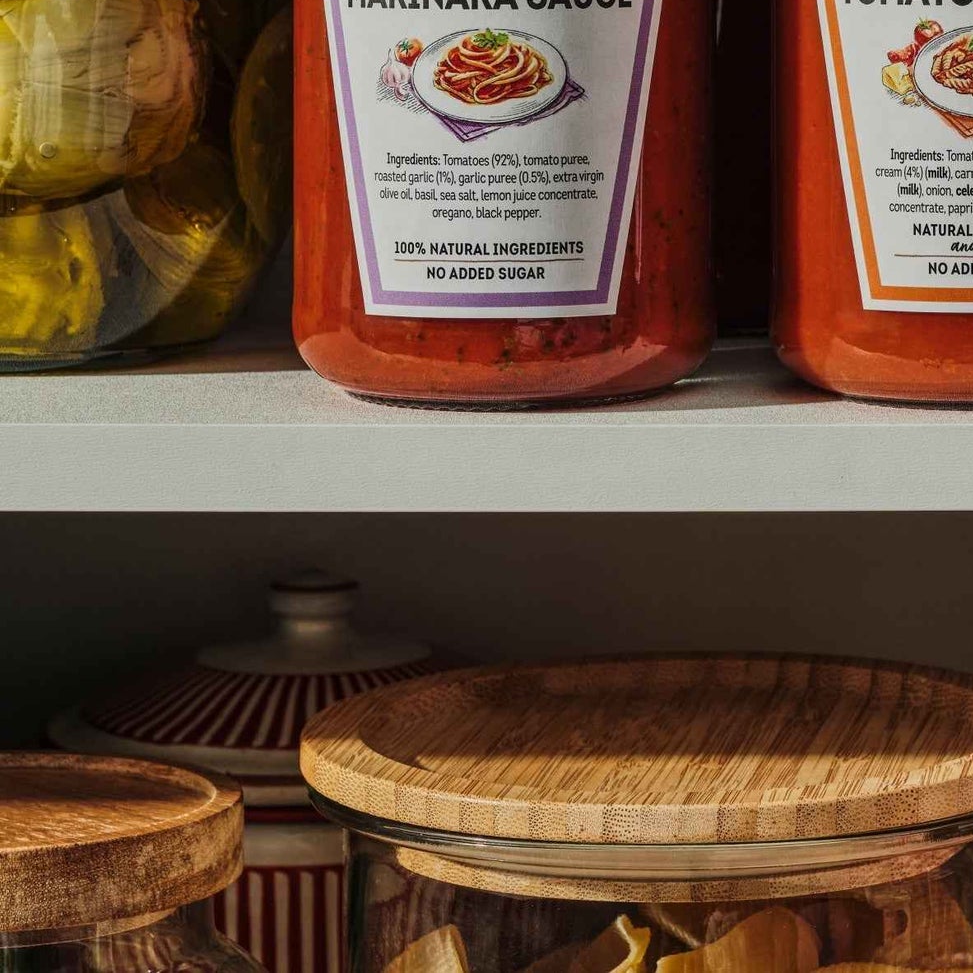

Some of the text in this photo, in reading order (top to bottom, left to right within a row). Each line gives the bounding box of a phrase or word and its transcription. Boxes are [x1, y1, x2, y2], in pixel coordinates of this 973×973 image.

[387, 152, 590, 168] Ingredients: Tomatoes (92%), tomato puree,
[890, 148, 944, 164] Ingredients:
[374, 170, 604, 187] roasted garlic (1%), garlic puree (0.5%), extra virgin
[875, 167, 903, 178] cream
[904, 166, 924, 179] (4%)
[925, 167, 954, 180] (milk),
[379, 188, 598, 204] olive oil, basil, sea salt, lemon juice concentrate,
[897, 184, 924, 197] (milk),
[925, 186, 954, 197] onion,
[432, 207, 542, 221] oregano, black pepper.
[889, 203, 946, 214] concentrate,
[913, 223, 973, 237] NATURAL
[394, 241, 584, 256] 100% NATURAL INGREDIENTS
[426, 267, 545, 280] NO ADDED SUGAR
[928, 261, 948, 275] NO
